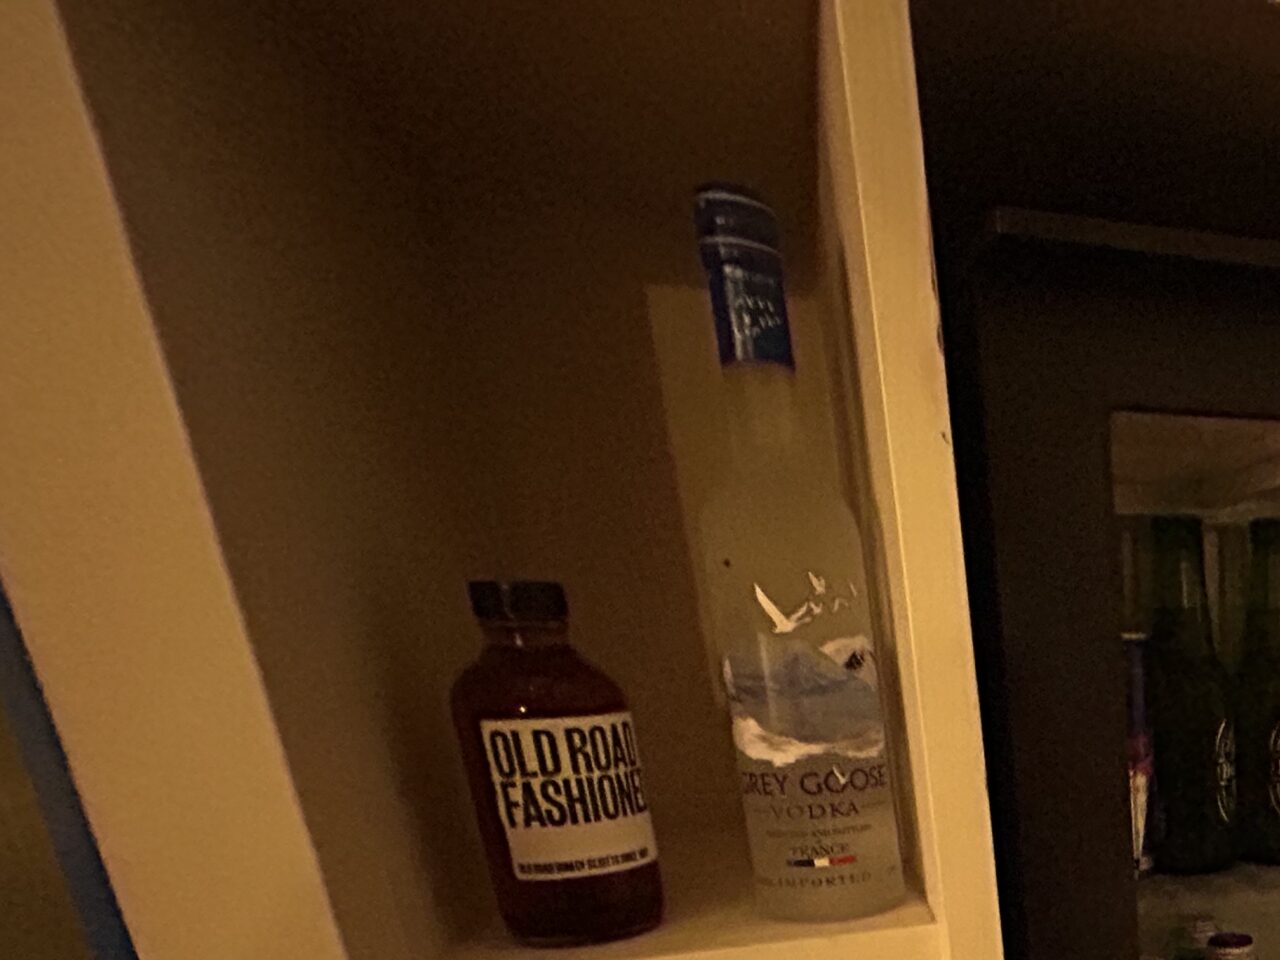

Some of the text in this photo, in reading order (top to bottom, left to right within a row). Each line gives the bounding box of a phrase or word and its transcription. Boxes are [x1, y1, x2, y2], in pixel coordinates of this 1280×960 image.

[489, 721, 638, 779] OLD ROAD
[500, 768, 649, 829] FASHIONE
[799, 763, 887, 796] GOOSE
[769, 800, 860, 820] VODKA
